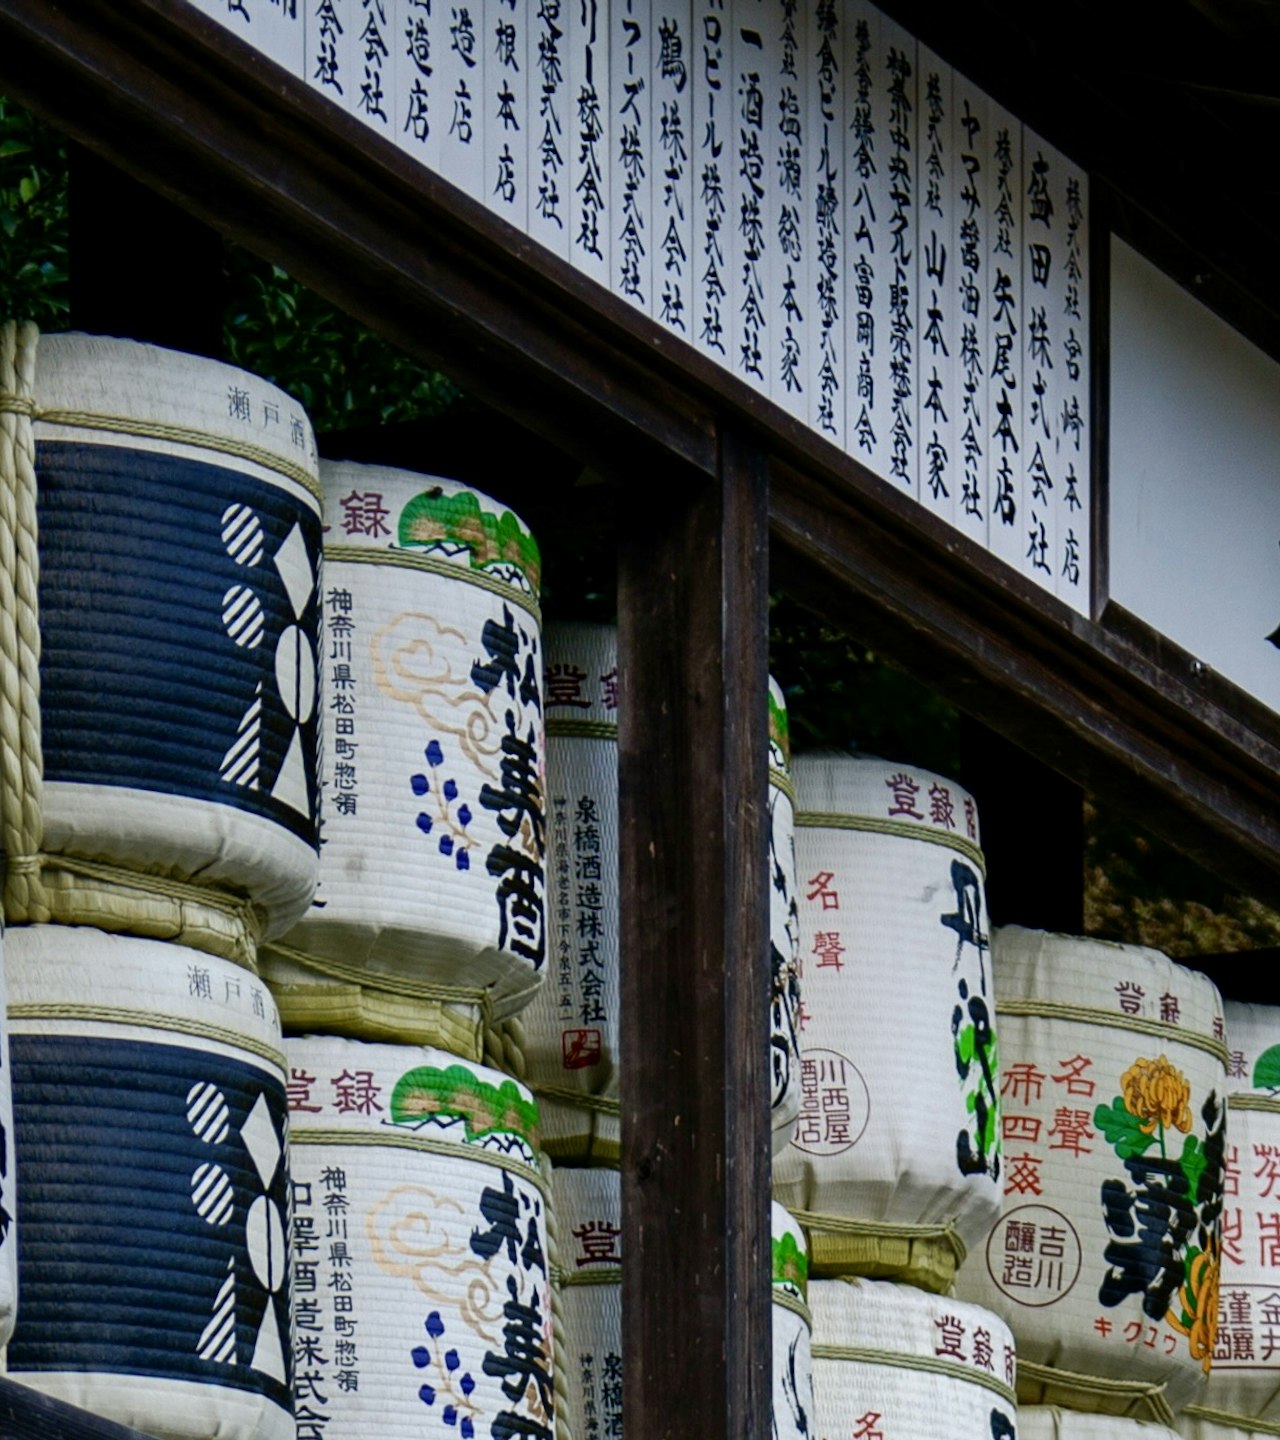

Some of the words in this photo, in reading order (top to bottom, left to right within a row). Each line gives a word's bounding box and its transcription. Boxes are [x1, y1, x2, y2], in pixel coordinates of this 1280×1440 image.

[923, 72, 950, 502] 株式会社山本本家
[990, 128, 1019, 528] 株式会社矢尾本店
[1026, 150, 1053, 577] 盛田株式会社
[227, 385, 320, 465] 瀬戸酒
[326, 587, 357, 816] 神奈川県松田町惣領
[186, 965, 280, 1028] 瀬戸酒
[573, 796, 608, 1025] 泉橋酒造株式会社
[319, 1166, 359, 1392] 神奈川県松田町惣領
